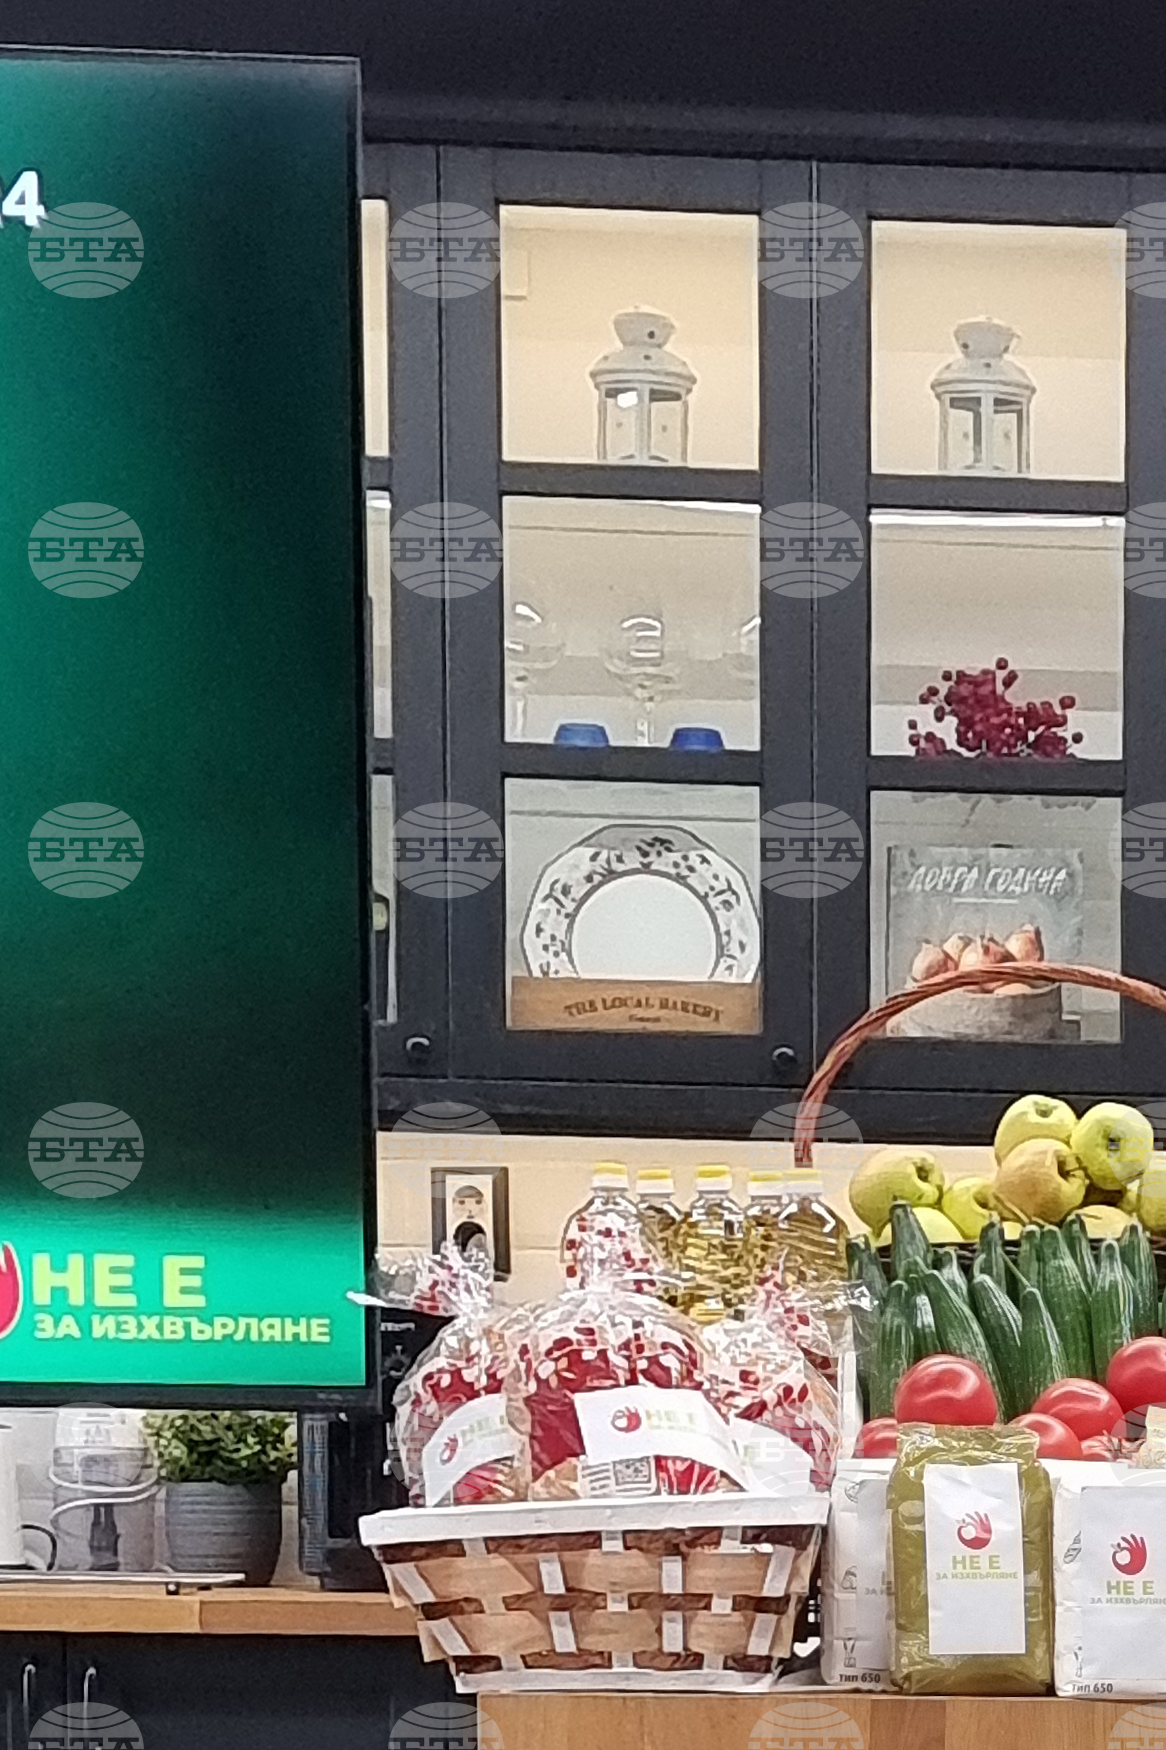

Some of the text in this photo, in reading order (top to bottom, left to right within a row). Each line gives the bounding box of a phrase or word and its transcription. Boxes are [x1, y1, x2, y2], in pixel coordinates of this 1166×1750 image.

[907, 866, 1067, 895] ДОБРА ГОДИНА
[32, 1253, 207, 1308] НЕ Е
[33, 1314, 331, 1343] ЗА ИЗХВЪРЛЯНЕ
[952, 1555, 1001, 1570] НЕ Е
[935, 1572, 948, 1580] ЗА
[1106, 1580, 1155, 1596] НЕ Е
[1090, 1597, 1103, 1605] ЗА
[860, 1672, 881, 1684] 650
[1093, 1682, 1114, 1694] 650
